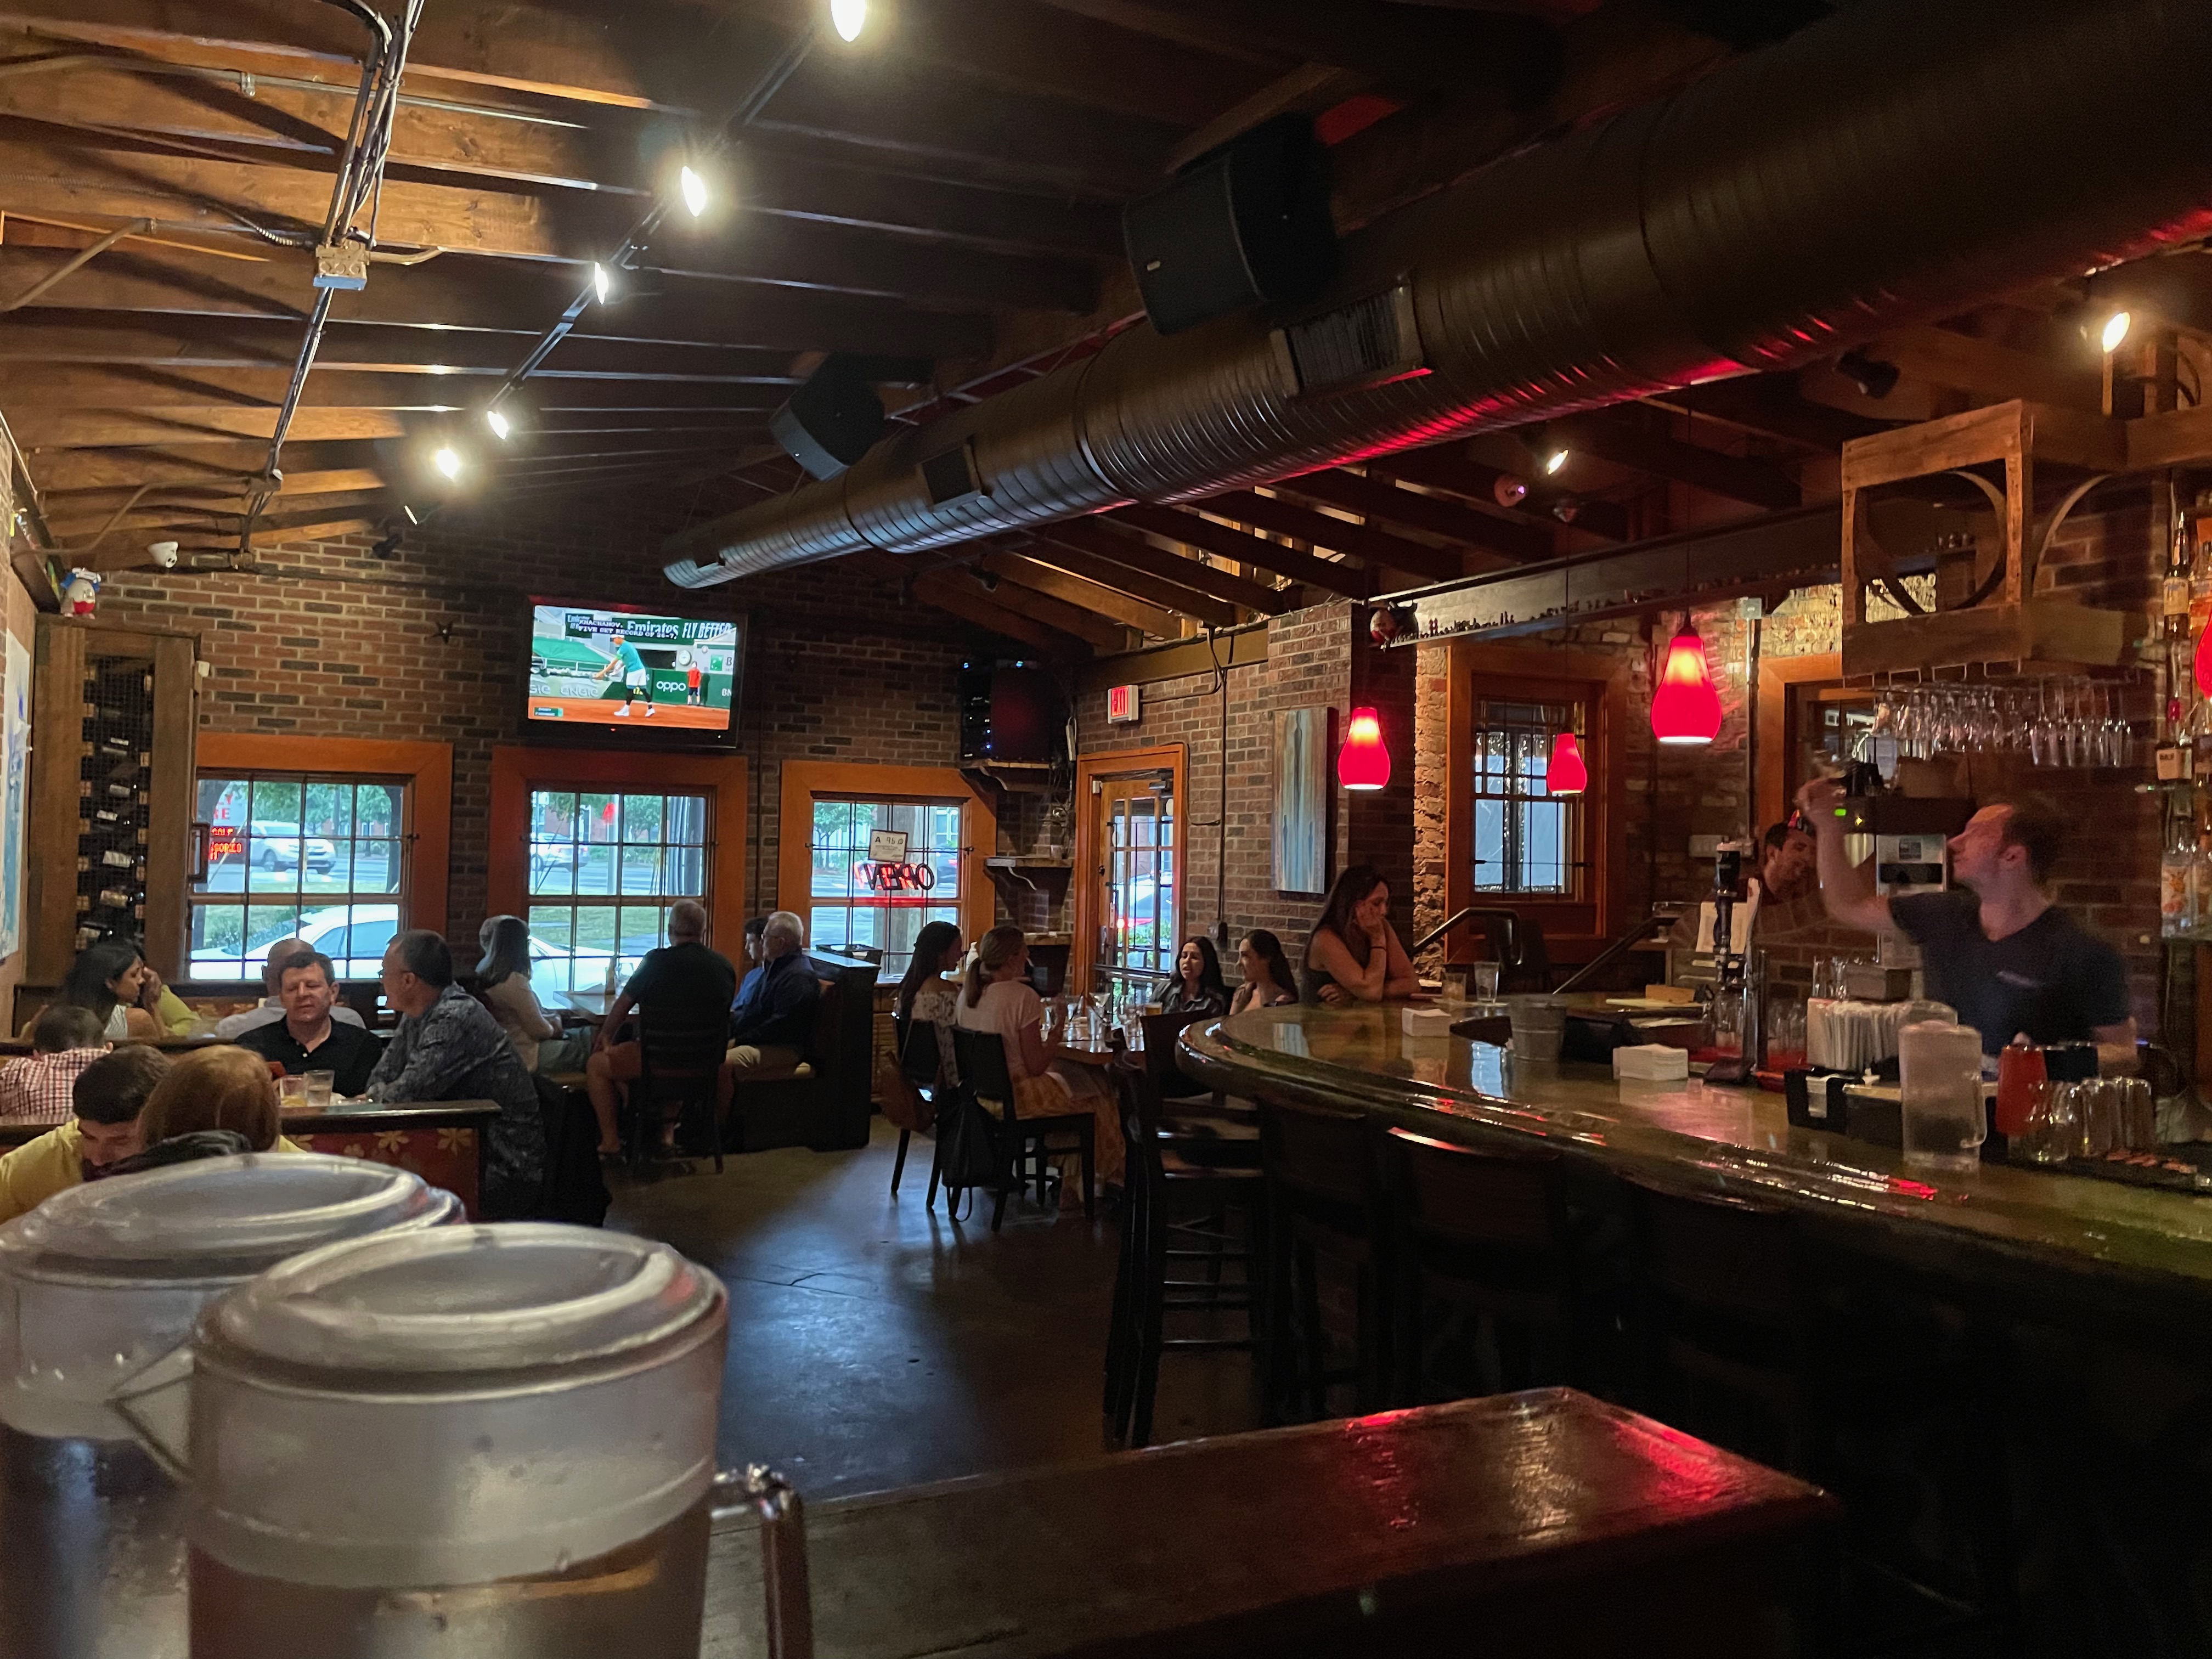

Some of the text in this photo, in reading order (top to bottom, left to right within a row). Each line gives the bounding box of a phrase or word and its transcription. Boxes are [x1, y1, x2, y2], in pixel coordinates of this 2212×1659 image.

[627, 620, 679, 636] Emirates
[682, 622, 698, 638] FLY
[1111, 687, 1128, 716] EXIT
